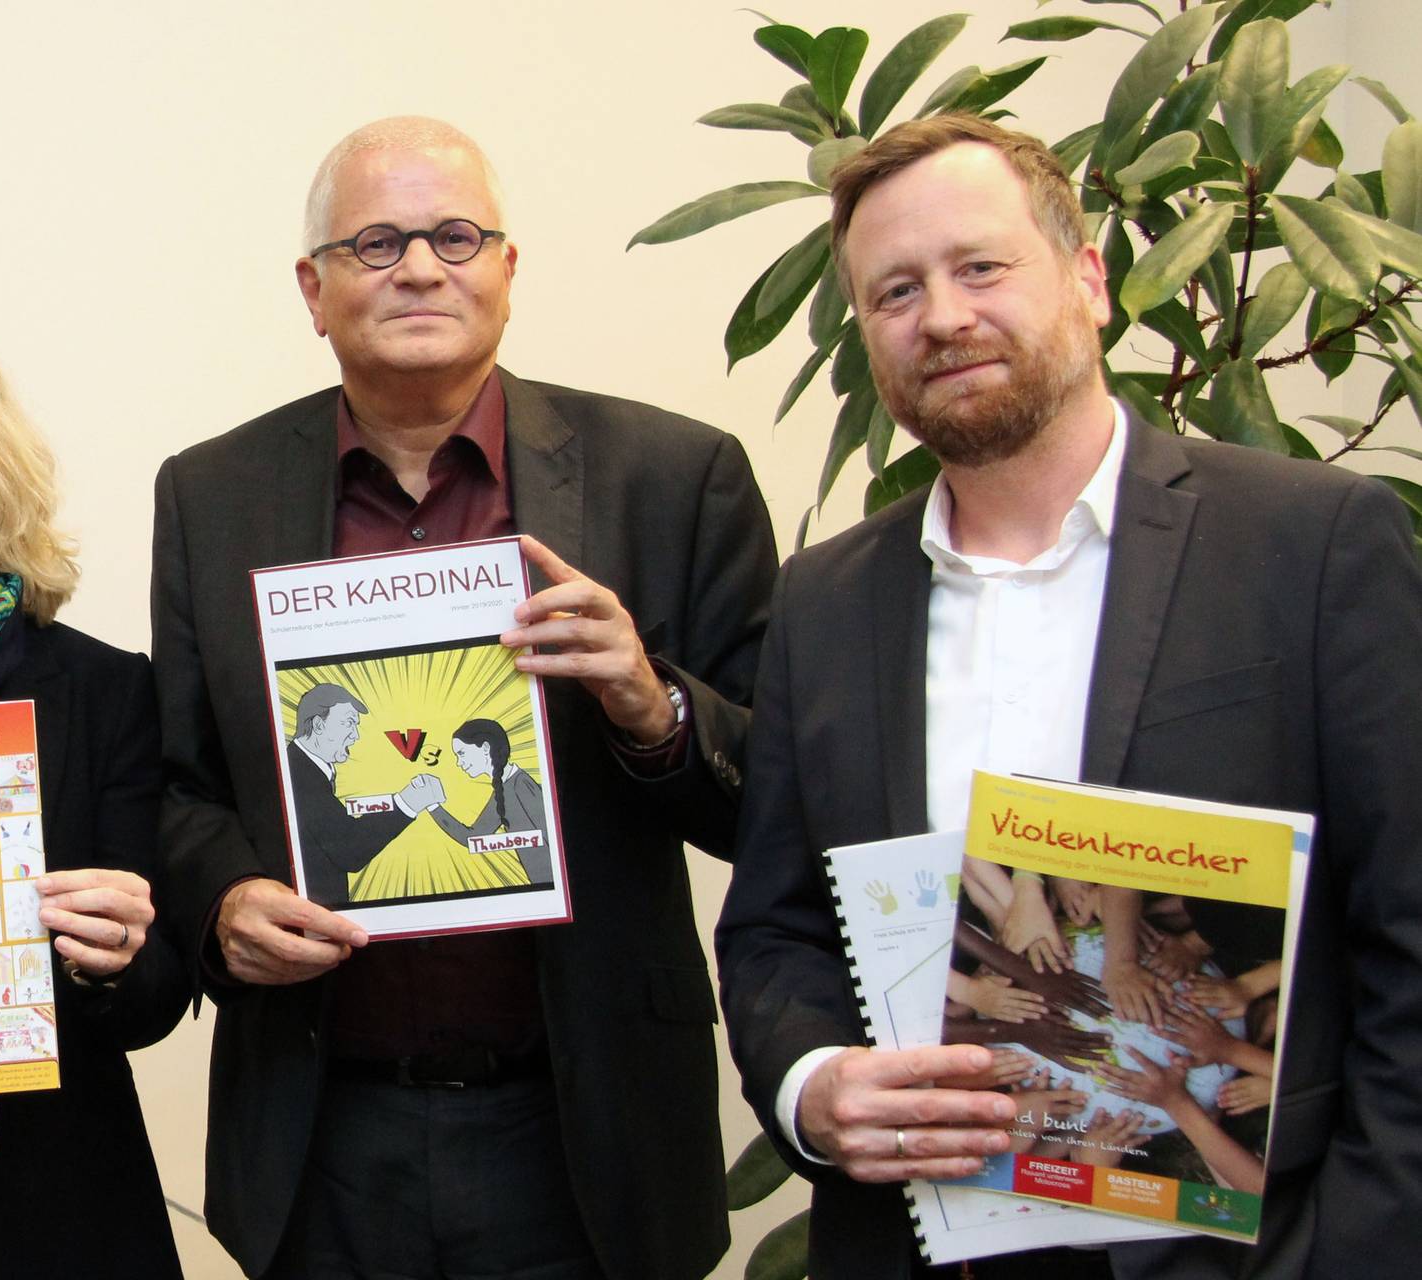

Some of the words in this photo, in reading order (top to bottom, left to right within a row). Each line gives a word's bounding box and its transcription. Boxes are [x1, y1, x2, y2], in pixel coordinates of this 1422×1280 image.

[268, 585, 337, 616] DER
[345, 563, 514, 607] KARDINAL
[346, 799, 391, 814] Trump
[469, 835, 540, 852] Thunberg
[990, 807, 1250, 875] Violenkracher
[1042, 1112, 1087, 1133] bunt
[1041, 1135, 1062, 1143] von
[1066, 1136, 1095, 1148] ihren
[1100, 1142, 1148, 1157] Ländern
[1028, 1161, 1078, 1176] FREIZEIT
[1107, 1174, 1162, 1191] BASTELN
